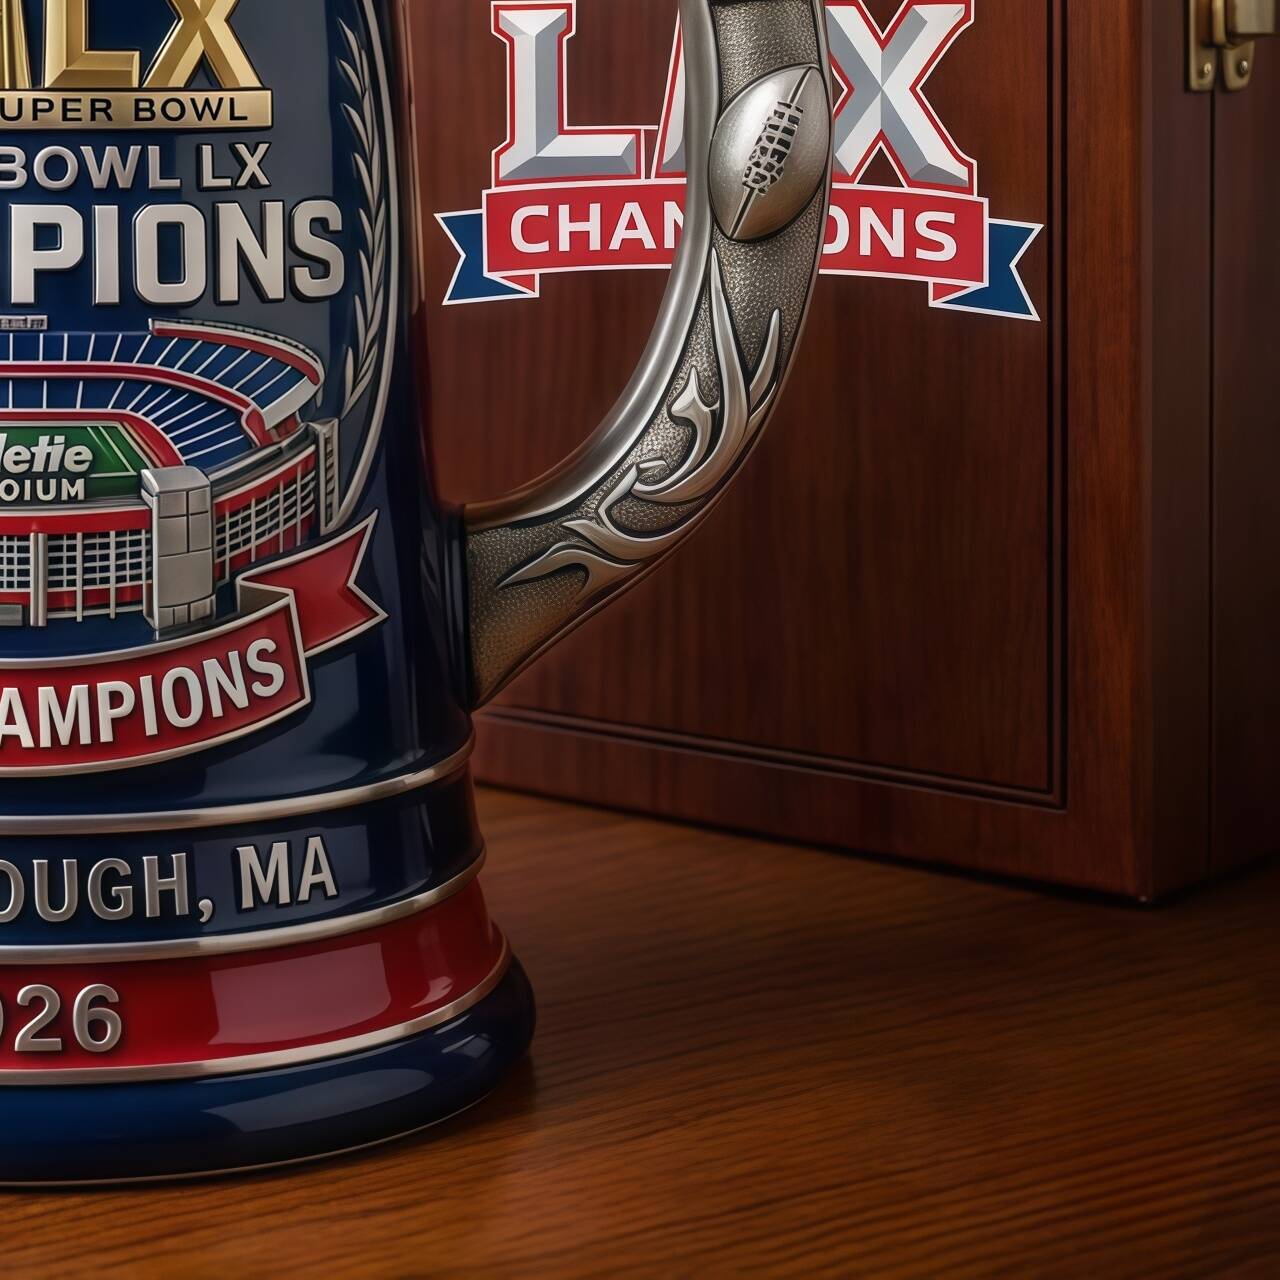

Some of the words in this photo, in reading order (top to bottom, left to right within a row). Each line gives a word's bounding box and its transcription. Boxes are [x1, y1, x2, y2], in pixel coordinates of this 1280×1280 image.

[133, 96, 248, 122] BOWL
[196, 142, 271, 189] LX
[510, 200, 957, 262] CHAONS
[236, 835, 339, 910] MA
